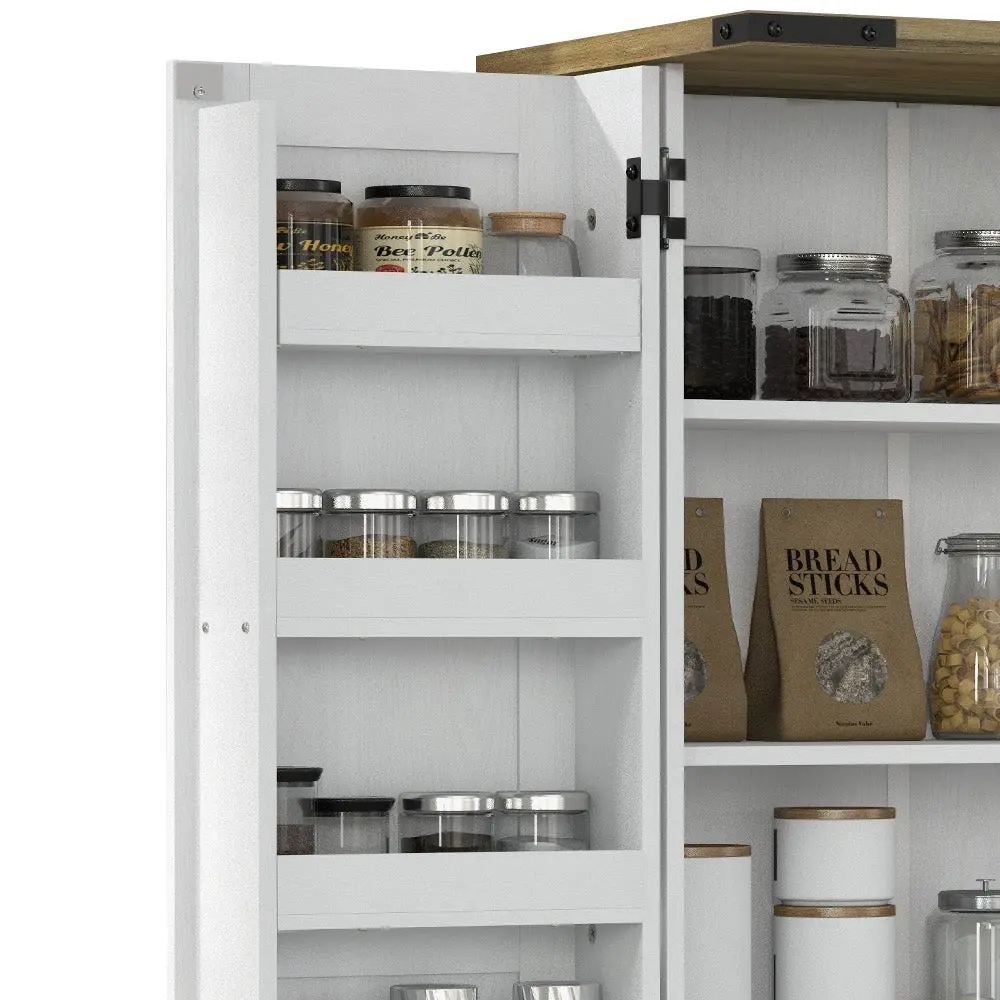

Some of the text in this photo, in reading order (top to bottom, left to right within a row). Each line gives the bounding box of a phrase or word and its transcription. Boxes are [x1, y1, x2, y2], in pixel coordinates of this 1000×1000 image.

[374, 245, 417, 257] Bee
[785, 548, 882, 572] BREAD
[788, 573, 889, 596] STICKS
